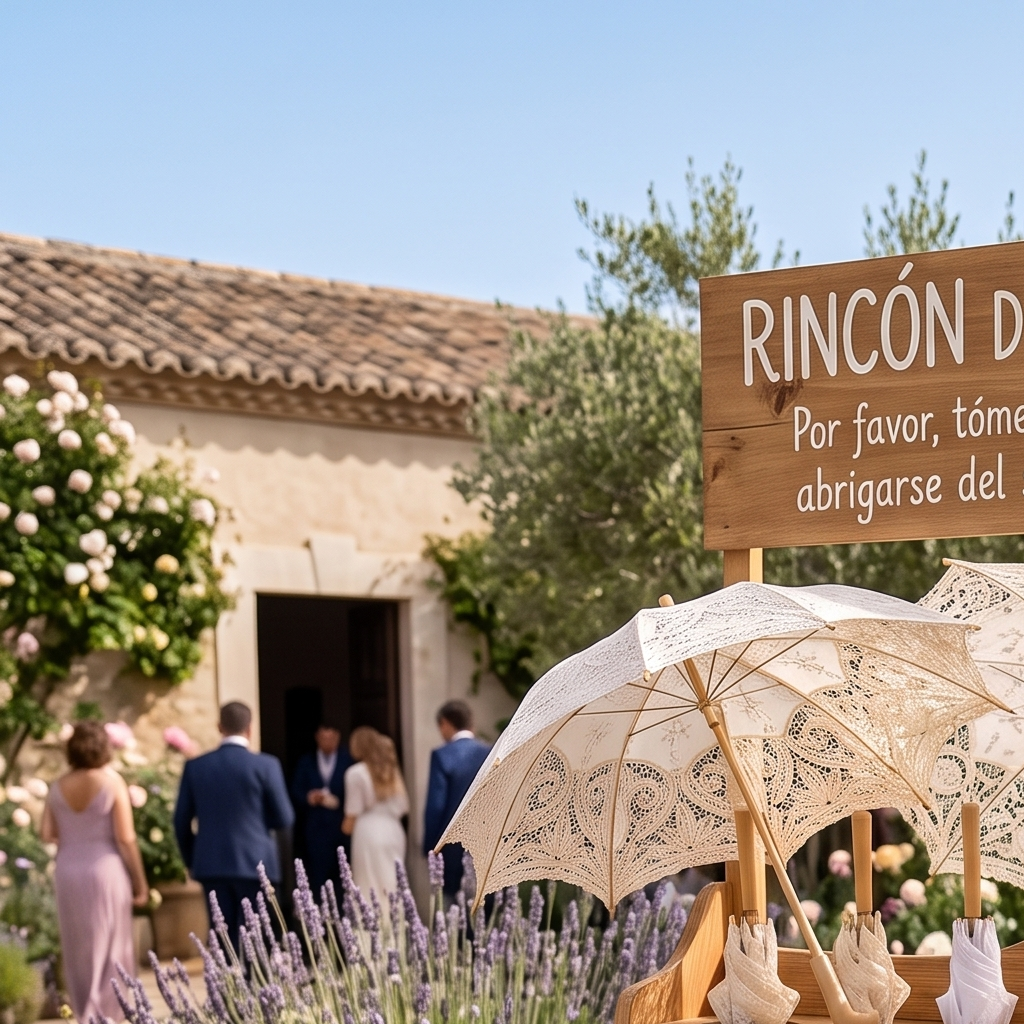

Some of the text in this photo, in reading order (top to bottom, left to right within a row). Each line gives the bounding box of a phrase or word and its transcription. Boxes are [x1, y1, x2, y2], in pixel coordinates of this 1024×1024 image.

[742, 262, 964, 387] RINCÓN
[793, 405, 842, 452] Por
[852, 401, 939, 460] favor,
[796, 466, 943, 525] abrigarse
[958, 452, 1007, 502] del
